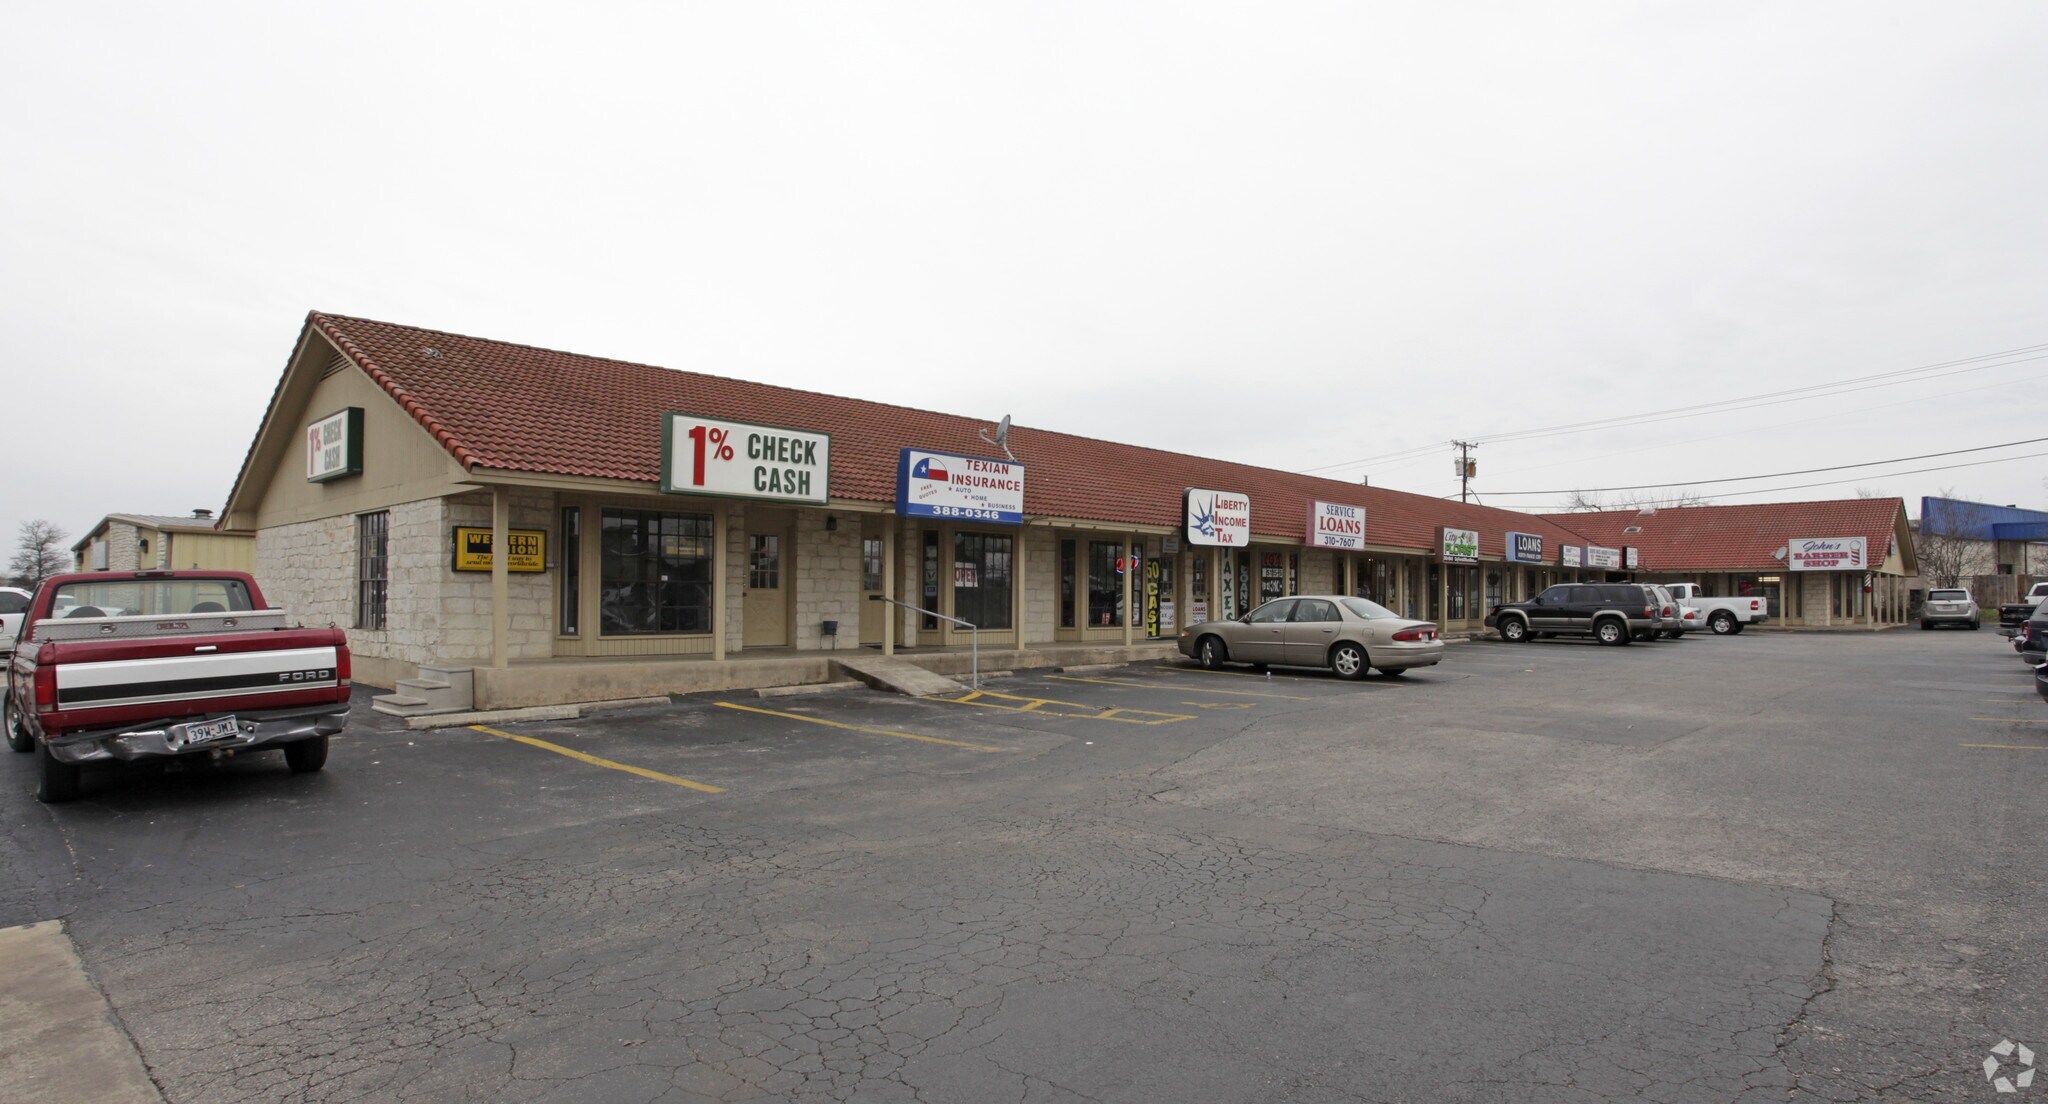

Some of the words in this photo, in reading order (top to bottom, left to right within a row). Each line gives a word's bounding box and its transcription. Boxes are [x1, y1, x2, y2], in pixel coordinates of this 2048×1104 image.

[323, 418, 342, 446] CHECK
[689, 425, 734, 486] 1%
[747, 433, 816, 465] CHECK
[324, 445, 340, 471] CASH
[966, 459, 1009, 475] TEXIAN
[754, 465, 810, 495] CASH
[920, 483, 933, 492] FREE
[951, 473, 1021, 492] INSURANCE
[919, 489, 938, 499] QUOTES
[955, 486, 972, 494] AUTO
[987, 502, 1016, 510] BUSINESS
[1215, 493, 1248, 511] LIBERTY
[932, 505, 1000, 519] 388-0346
[1214, 510, 1247, 527] INCOME
[1326, 504, 1356, 518] SERVICE
[1319, 515, 1361, 535] LOANS
[468, 534, 537, 546] WEERN
[1214, 528, 1233, 543] TAX
[1324, 535, 1356, 548] 310-7607
[1445, 531, 1458, 545] City
[1518, 536, 1541, 552] LOANS
[1802, 541, 1841, 552] John's
[1793, 552, 1849, 560] BARBER
[955, 567, 977, 583] OPEN
[1240, 564, 1248, 610] LOANS
[279, 669, 330, 682] FORD
